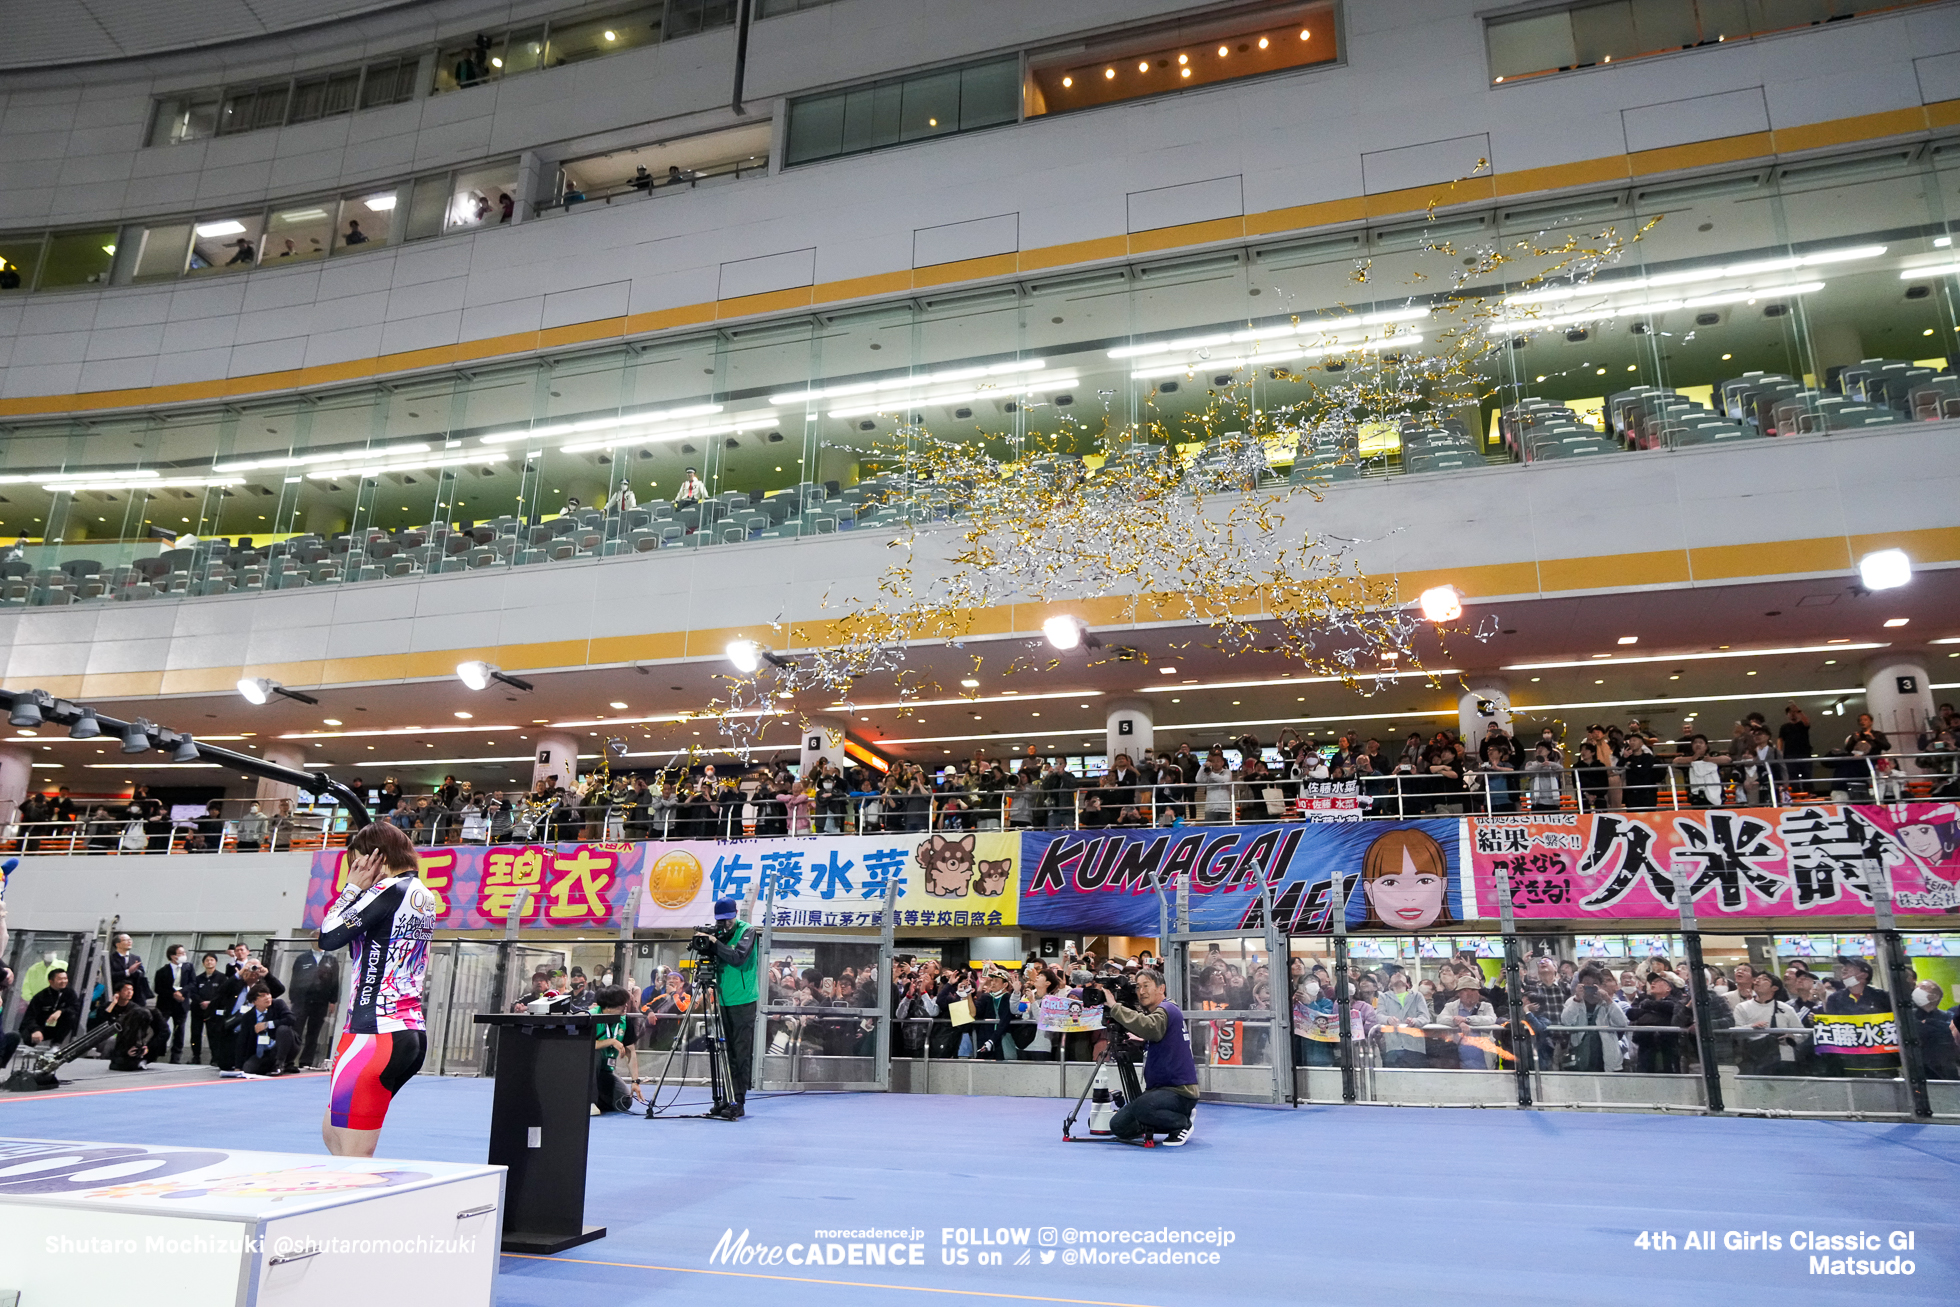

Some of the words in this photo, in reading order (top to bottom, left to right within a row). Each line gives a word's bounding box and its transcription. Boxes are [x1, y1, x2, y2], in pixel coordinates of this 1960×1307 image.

[1902, 679, 1912, 690] 3
[1122, 723, 1129, 732] 5
[811, 739, 818, 748] 6
[541, 753, 547, 761] 7
[1308, 780, 1358, 794] 佐藤水菜
[1027, 828, 1306, 895] KUMAGAI
[709, 849, 910, 902] 佐藤水菜
[641, 944, 649, 955] 6
[1044, 942, 1053, 953] 5
[1538, 938, 1549, 951] 4
